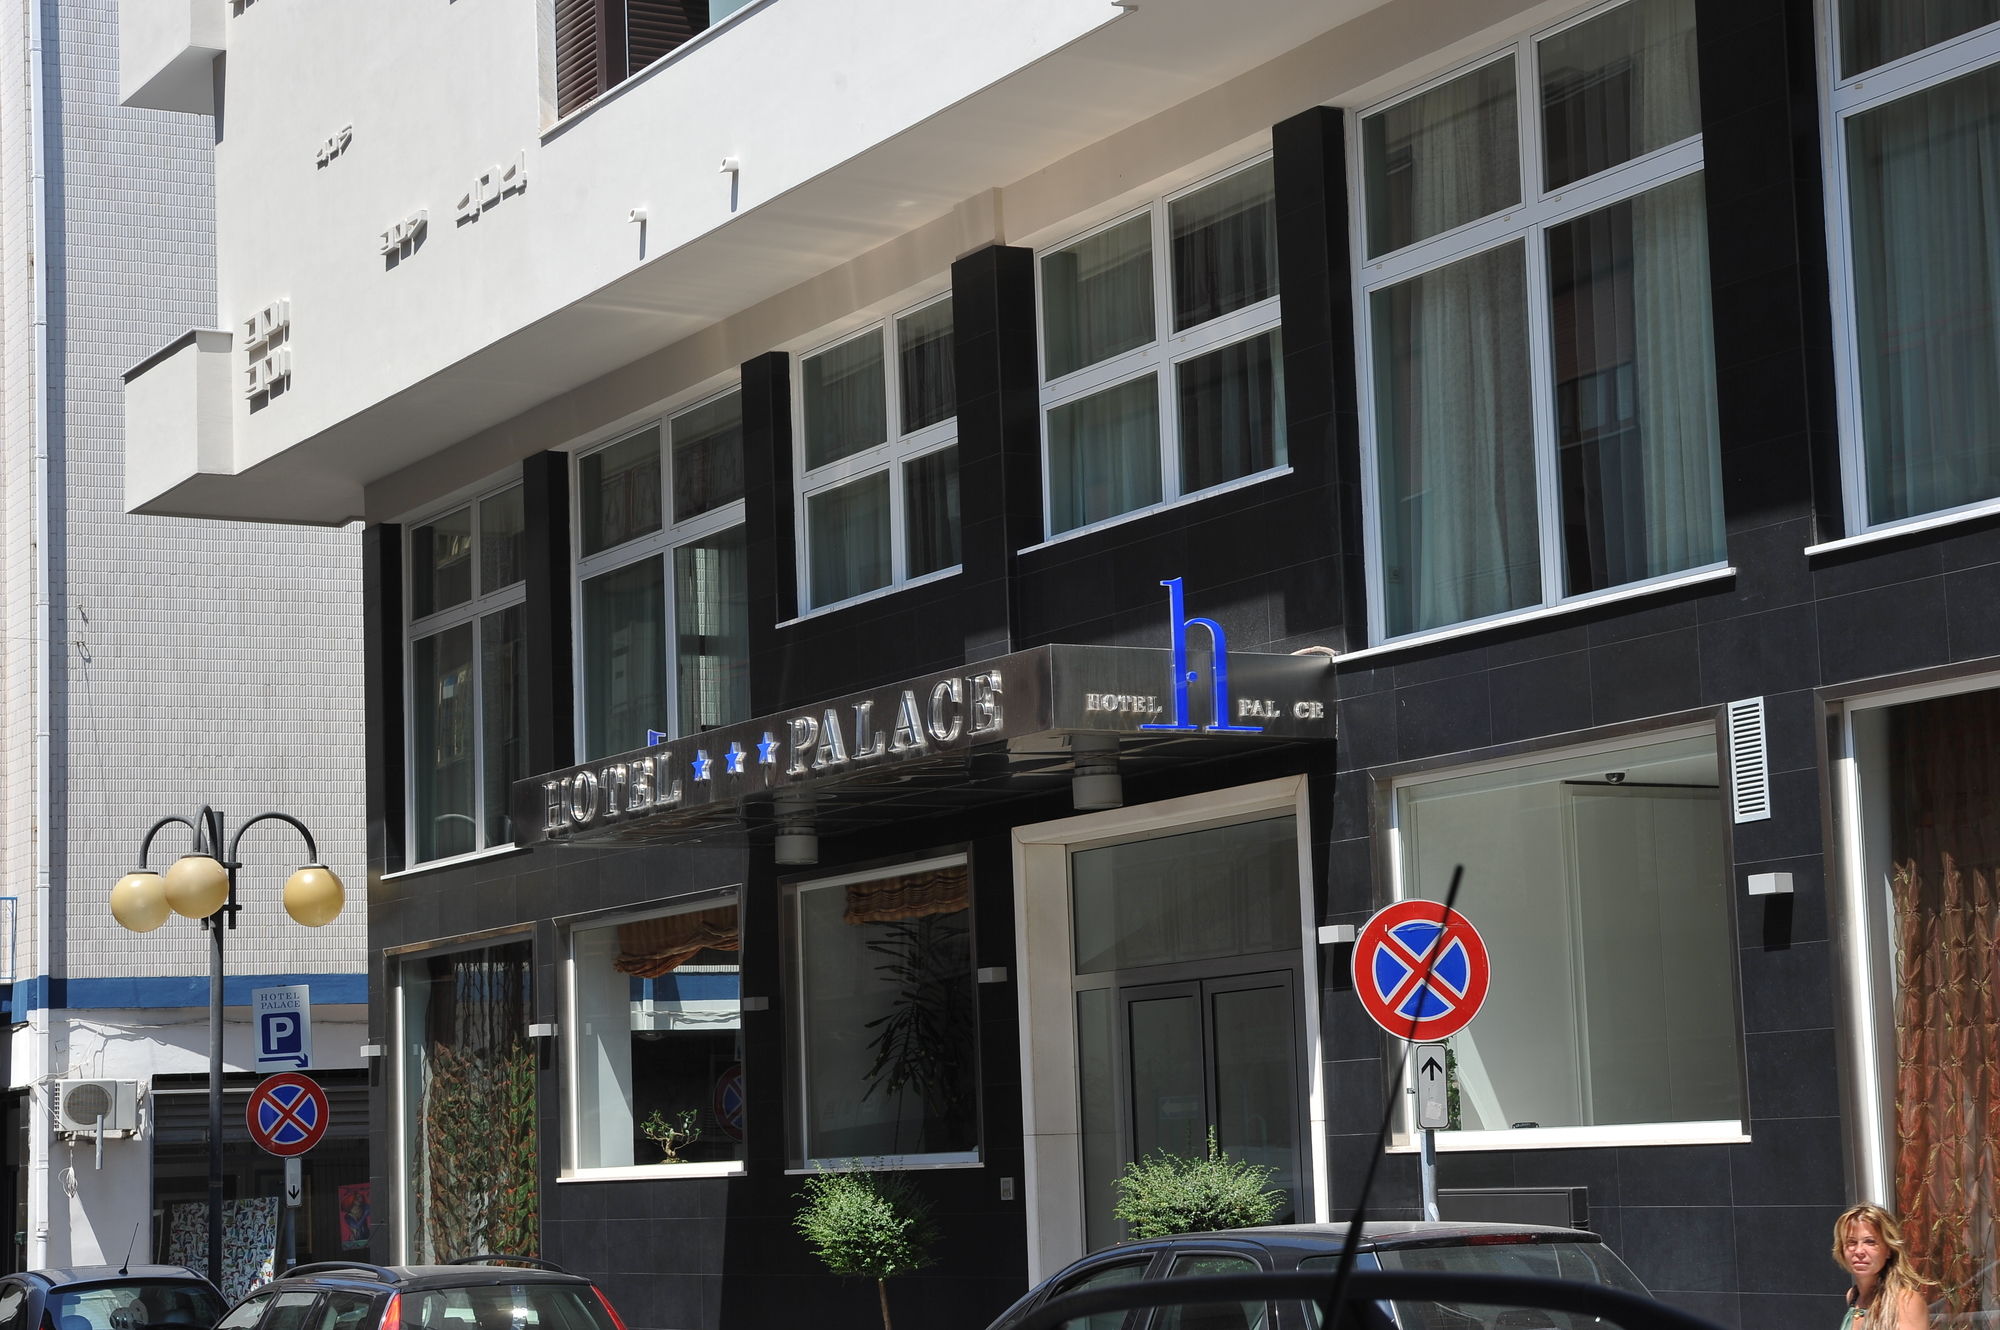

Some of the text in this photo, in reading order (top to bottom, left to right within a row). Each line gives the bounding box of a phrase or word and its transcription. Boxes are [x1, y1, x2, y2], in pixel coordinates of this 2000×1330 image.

[1139, 576, 1264, 733] h
[1085, 693, 1163, 714] HOTEL
[542, 669, 1004, 831] HOTEL PALACE
[260, 991, 300, 1001] HOTEL
[260, 1000, 301, 1010] PALACE
[269, 1017, 295, 1050] P
